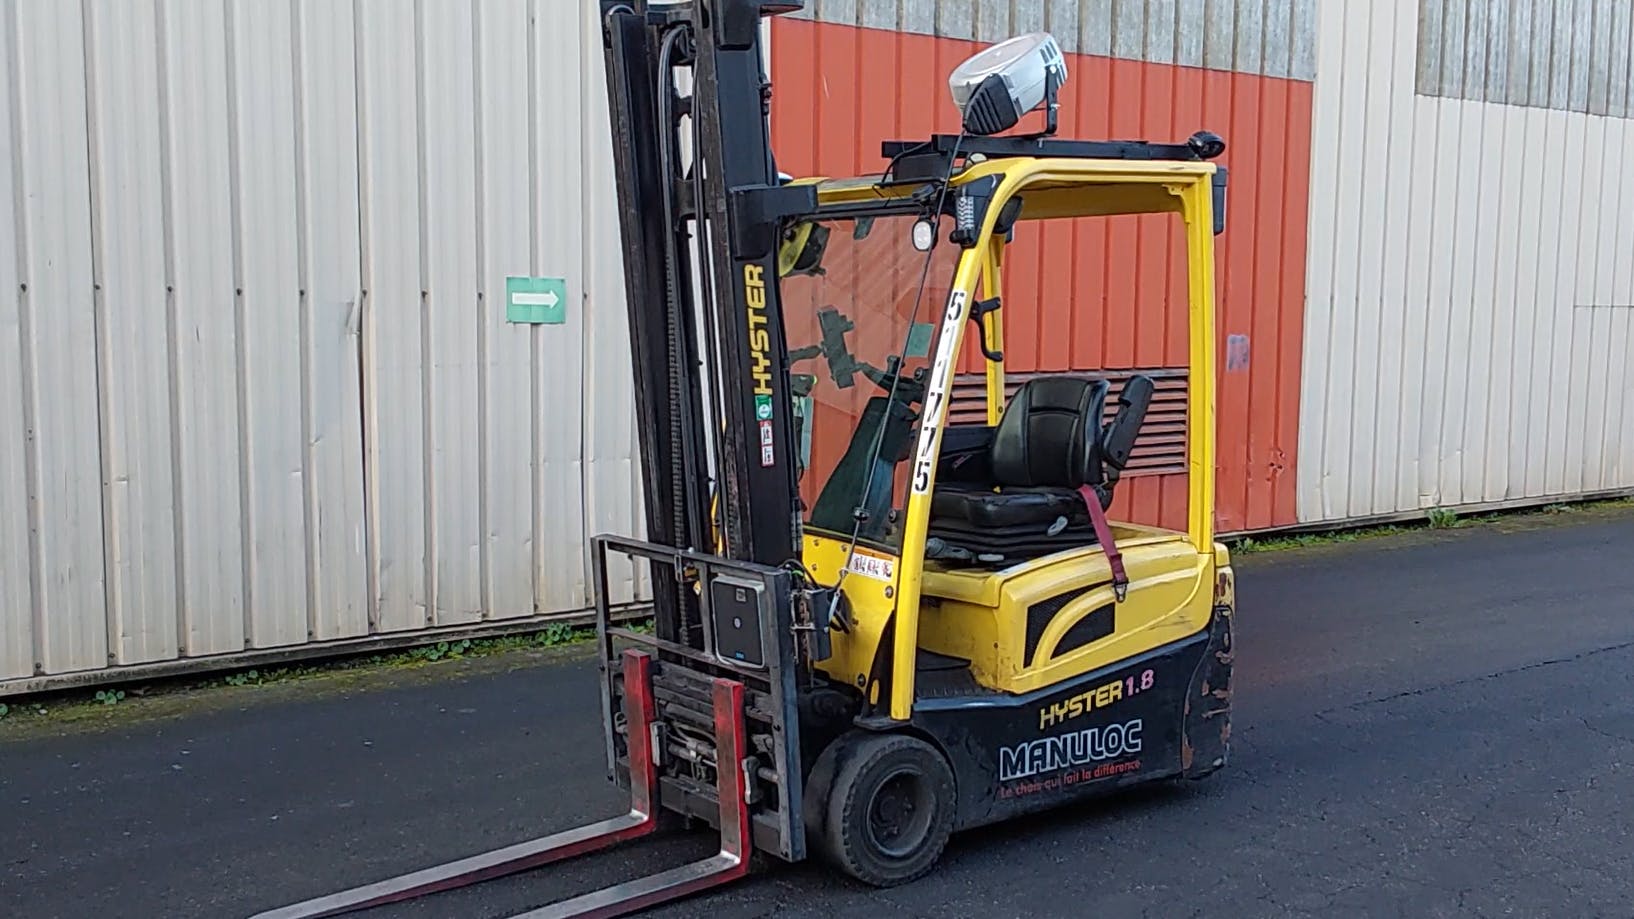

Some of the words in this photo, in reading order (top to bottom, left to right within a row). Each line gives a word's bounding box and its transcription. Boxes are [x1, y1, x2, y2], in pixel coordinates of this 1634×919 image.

[744, 264, 773, 395] HYSTER
[1039, 680, 1123, 730] HYSTER
[1126, 669, 1154, 696] 1.8
[1000, 719, 1142, 781] MANULOC
[1063, 771, 1079, 785] fait
[1082, 768, 1091, 780] la
